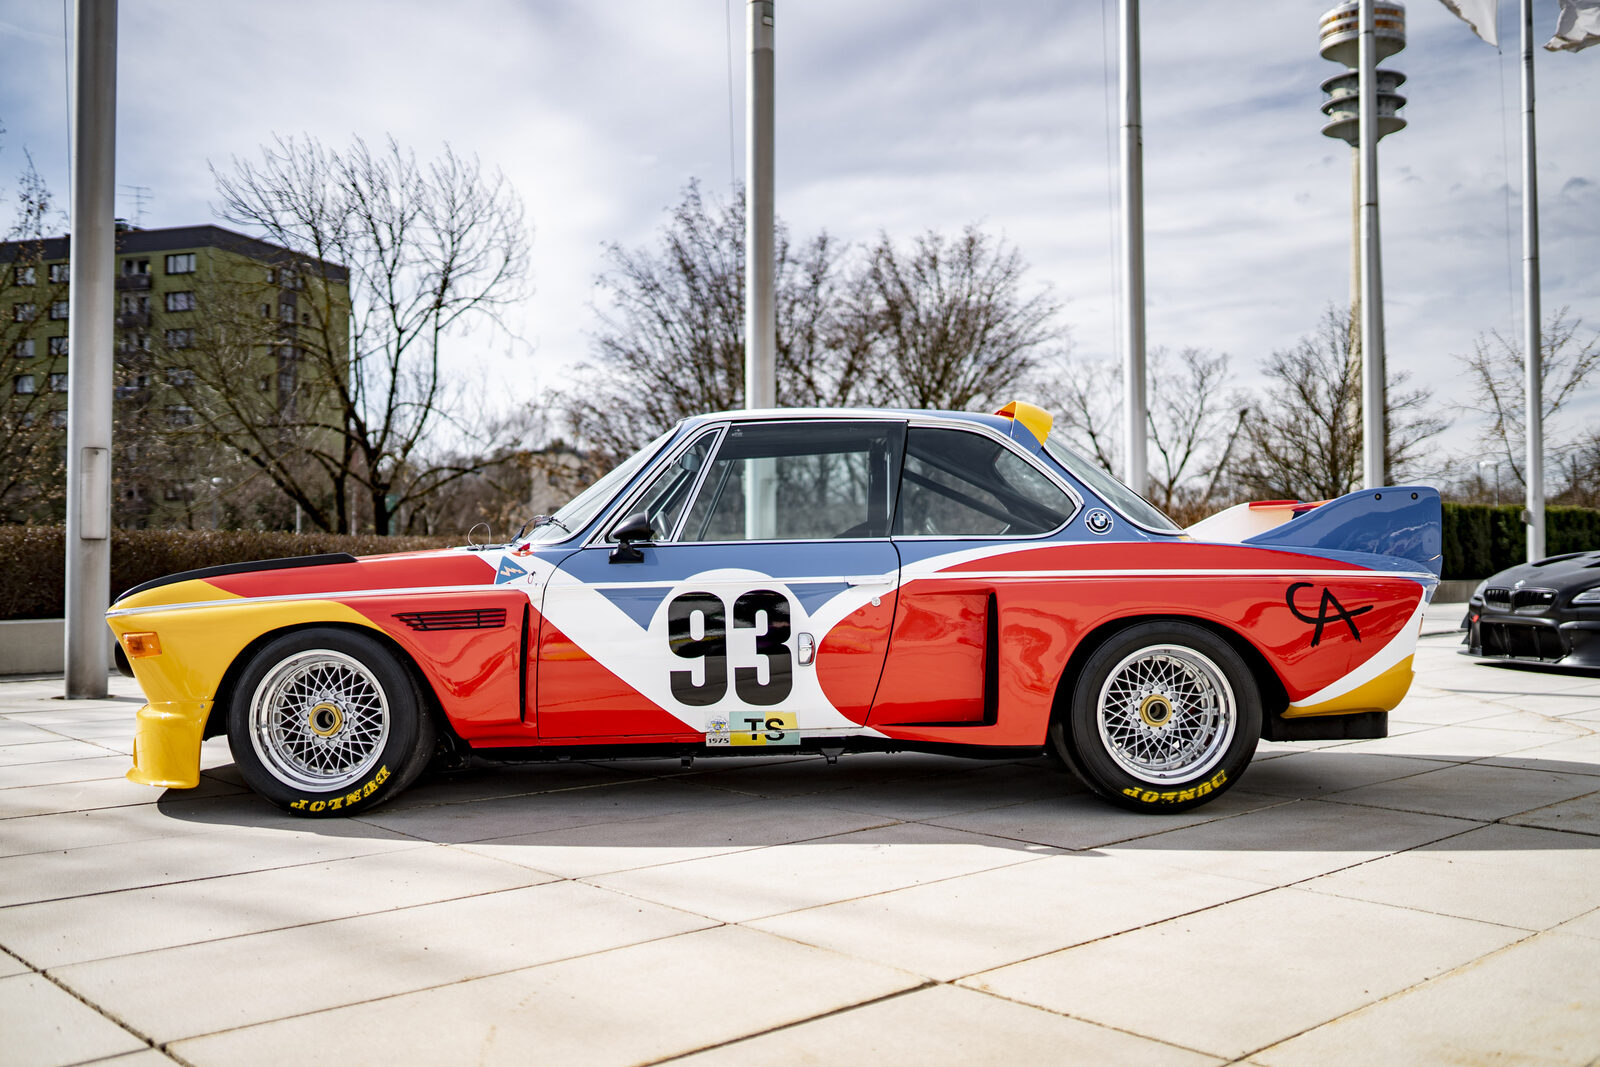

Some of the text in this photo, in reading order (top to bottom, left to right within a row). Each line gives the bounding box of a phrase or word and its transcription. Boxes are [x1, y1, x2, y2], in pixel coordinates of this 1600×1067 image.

[668, 589, 793, 706] 93
[744, 718, 785, 741] TS
[290, 764, 391, 812] DUNLOP
[1122, 769, 1228, 804] DUNLOP
